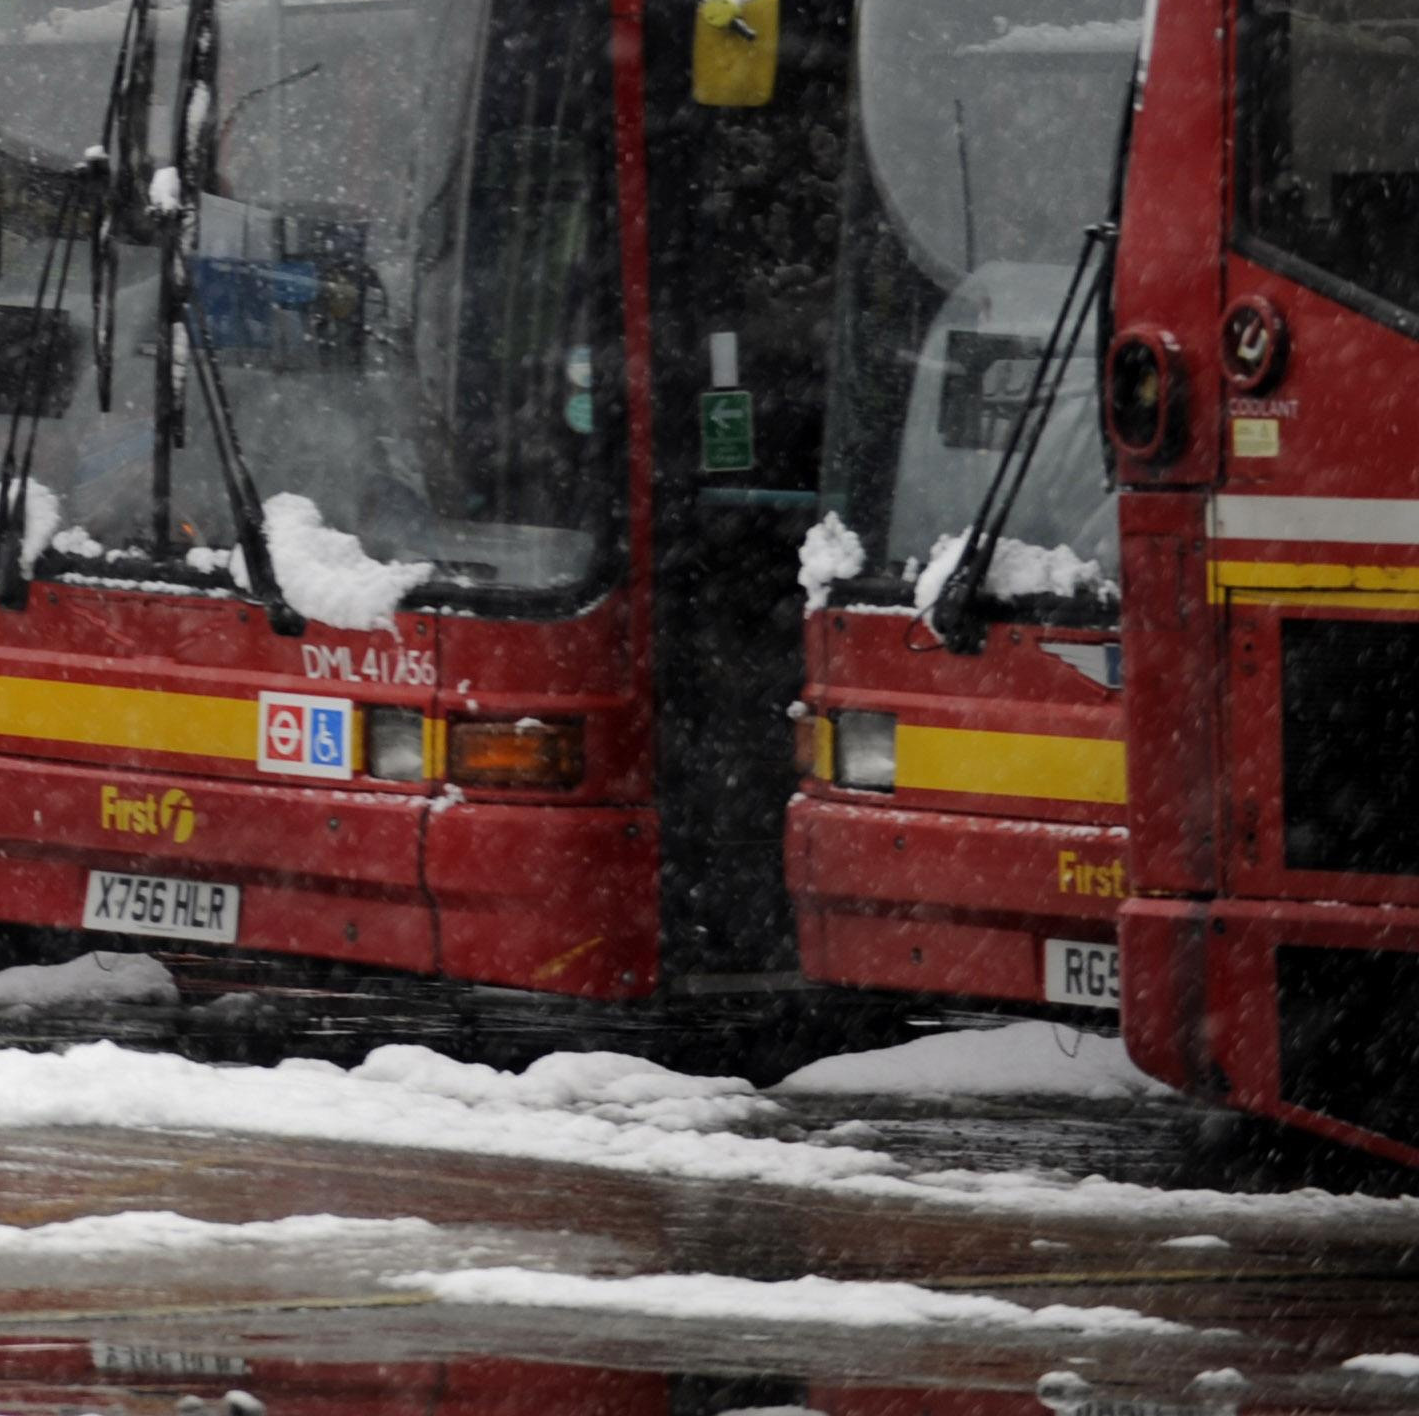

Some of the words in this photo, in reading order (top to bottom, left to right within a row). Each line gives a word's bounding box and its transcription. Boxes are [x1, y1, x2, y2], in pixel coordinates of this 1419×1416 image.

[1228, 398, 1298, 417] COOLANT
[101, 786, 158, 834] First
[1059, 851, 1126, 898] First
[95, 876, 167, 923] X756
[173, 883, 225, 930] HLR
